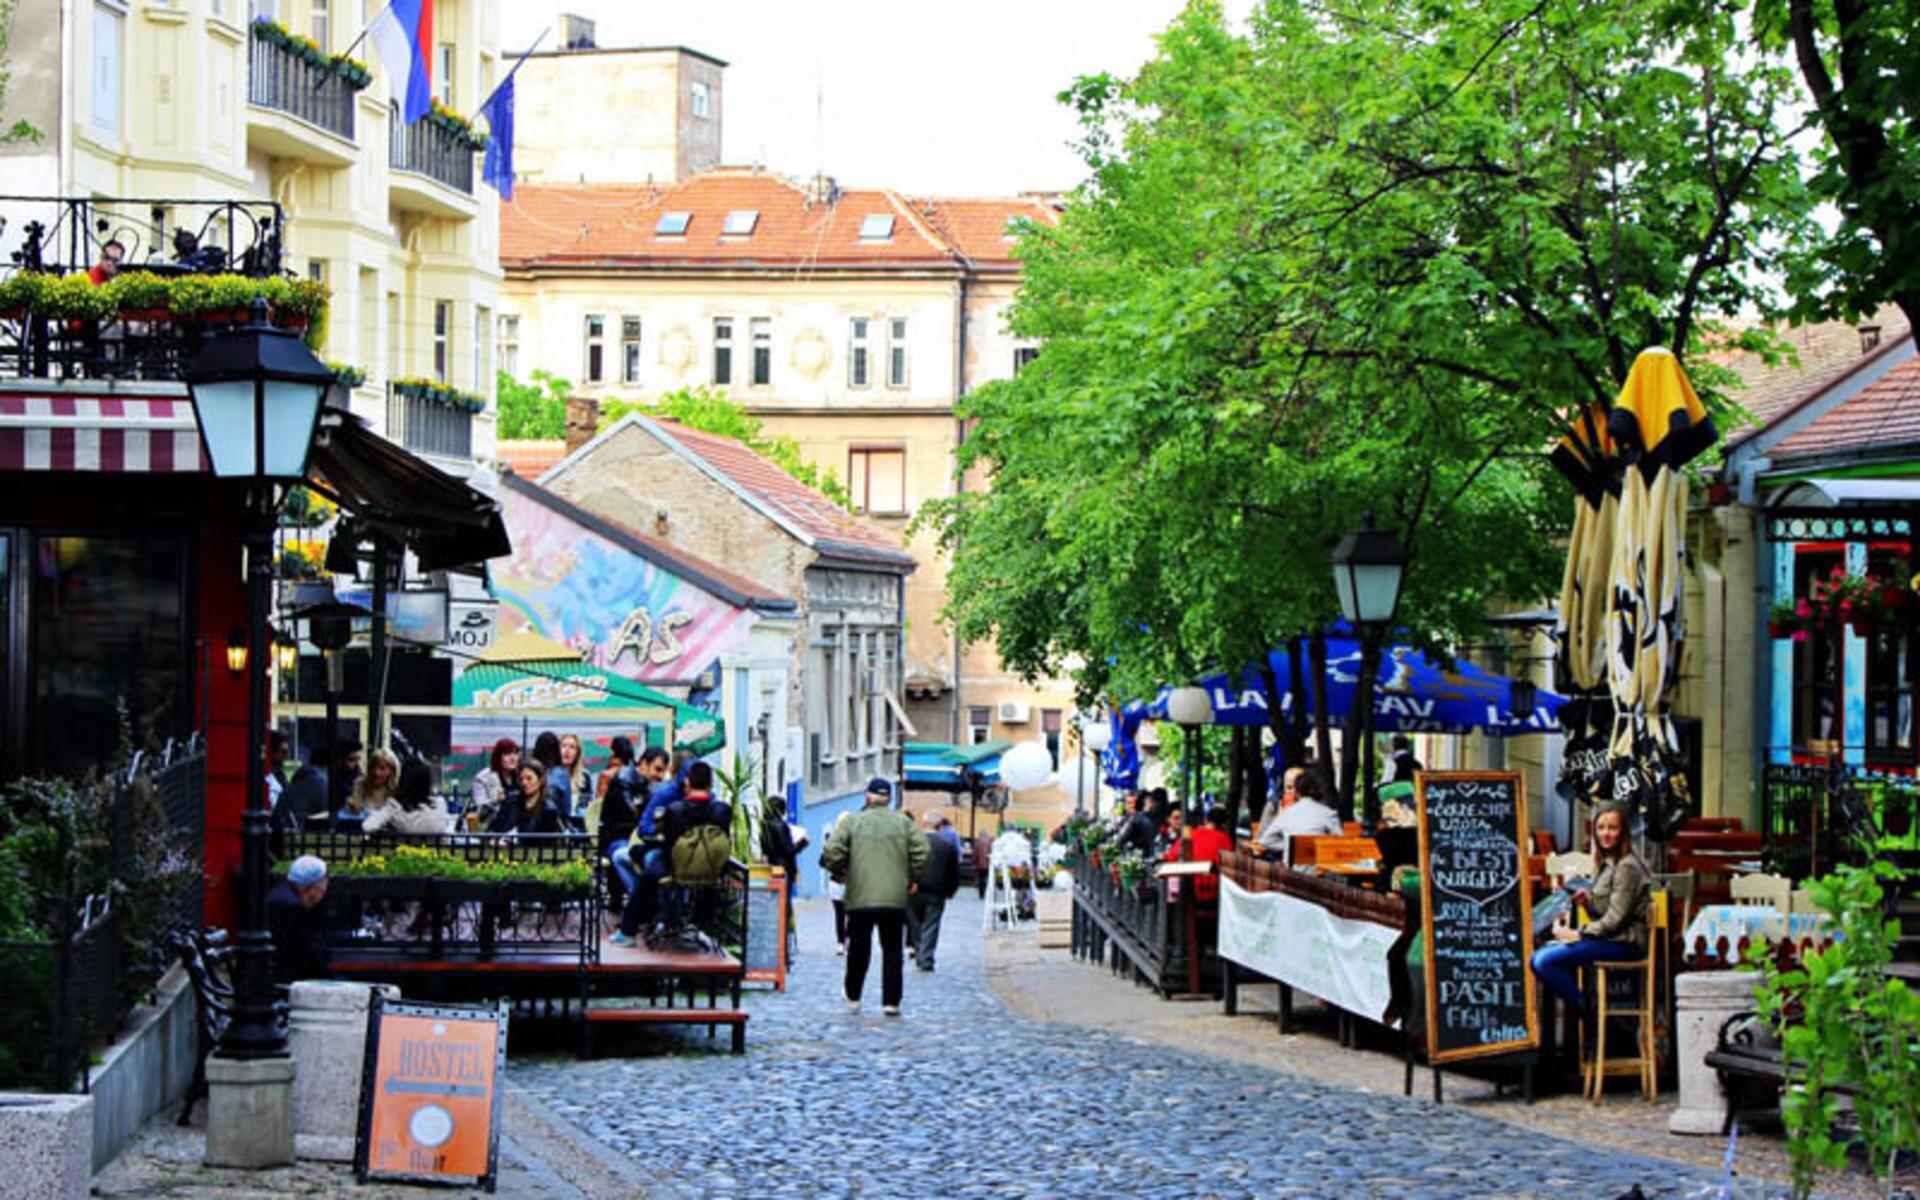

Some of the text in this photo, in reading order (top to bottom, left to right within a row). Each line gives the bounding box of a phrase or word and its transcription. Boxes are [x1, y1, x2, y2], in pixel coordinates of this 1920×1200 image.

[607, 606, 694, 667] AS
[1373, 694, 1434, 717] AV
[1453, 850, 1516, 872] BEST
[400, 1039, 485, 1081] HOSTEL
